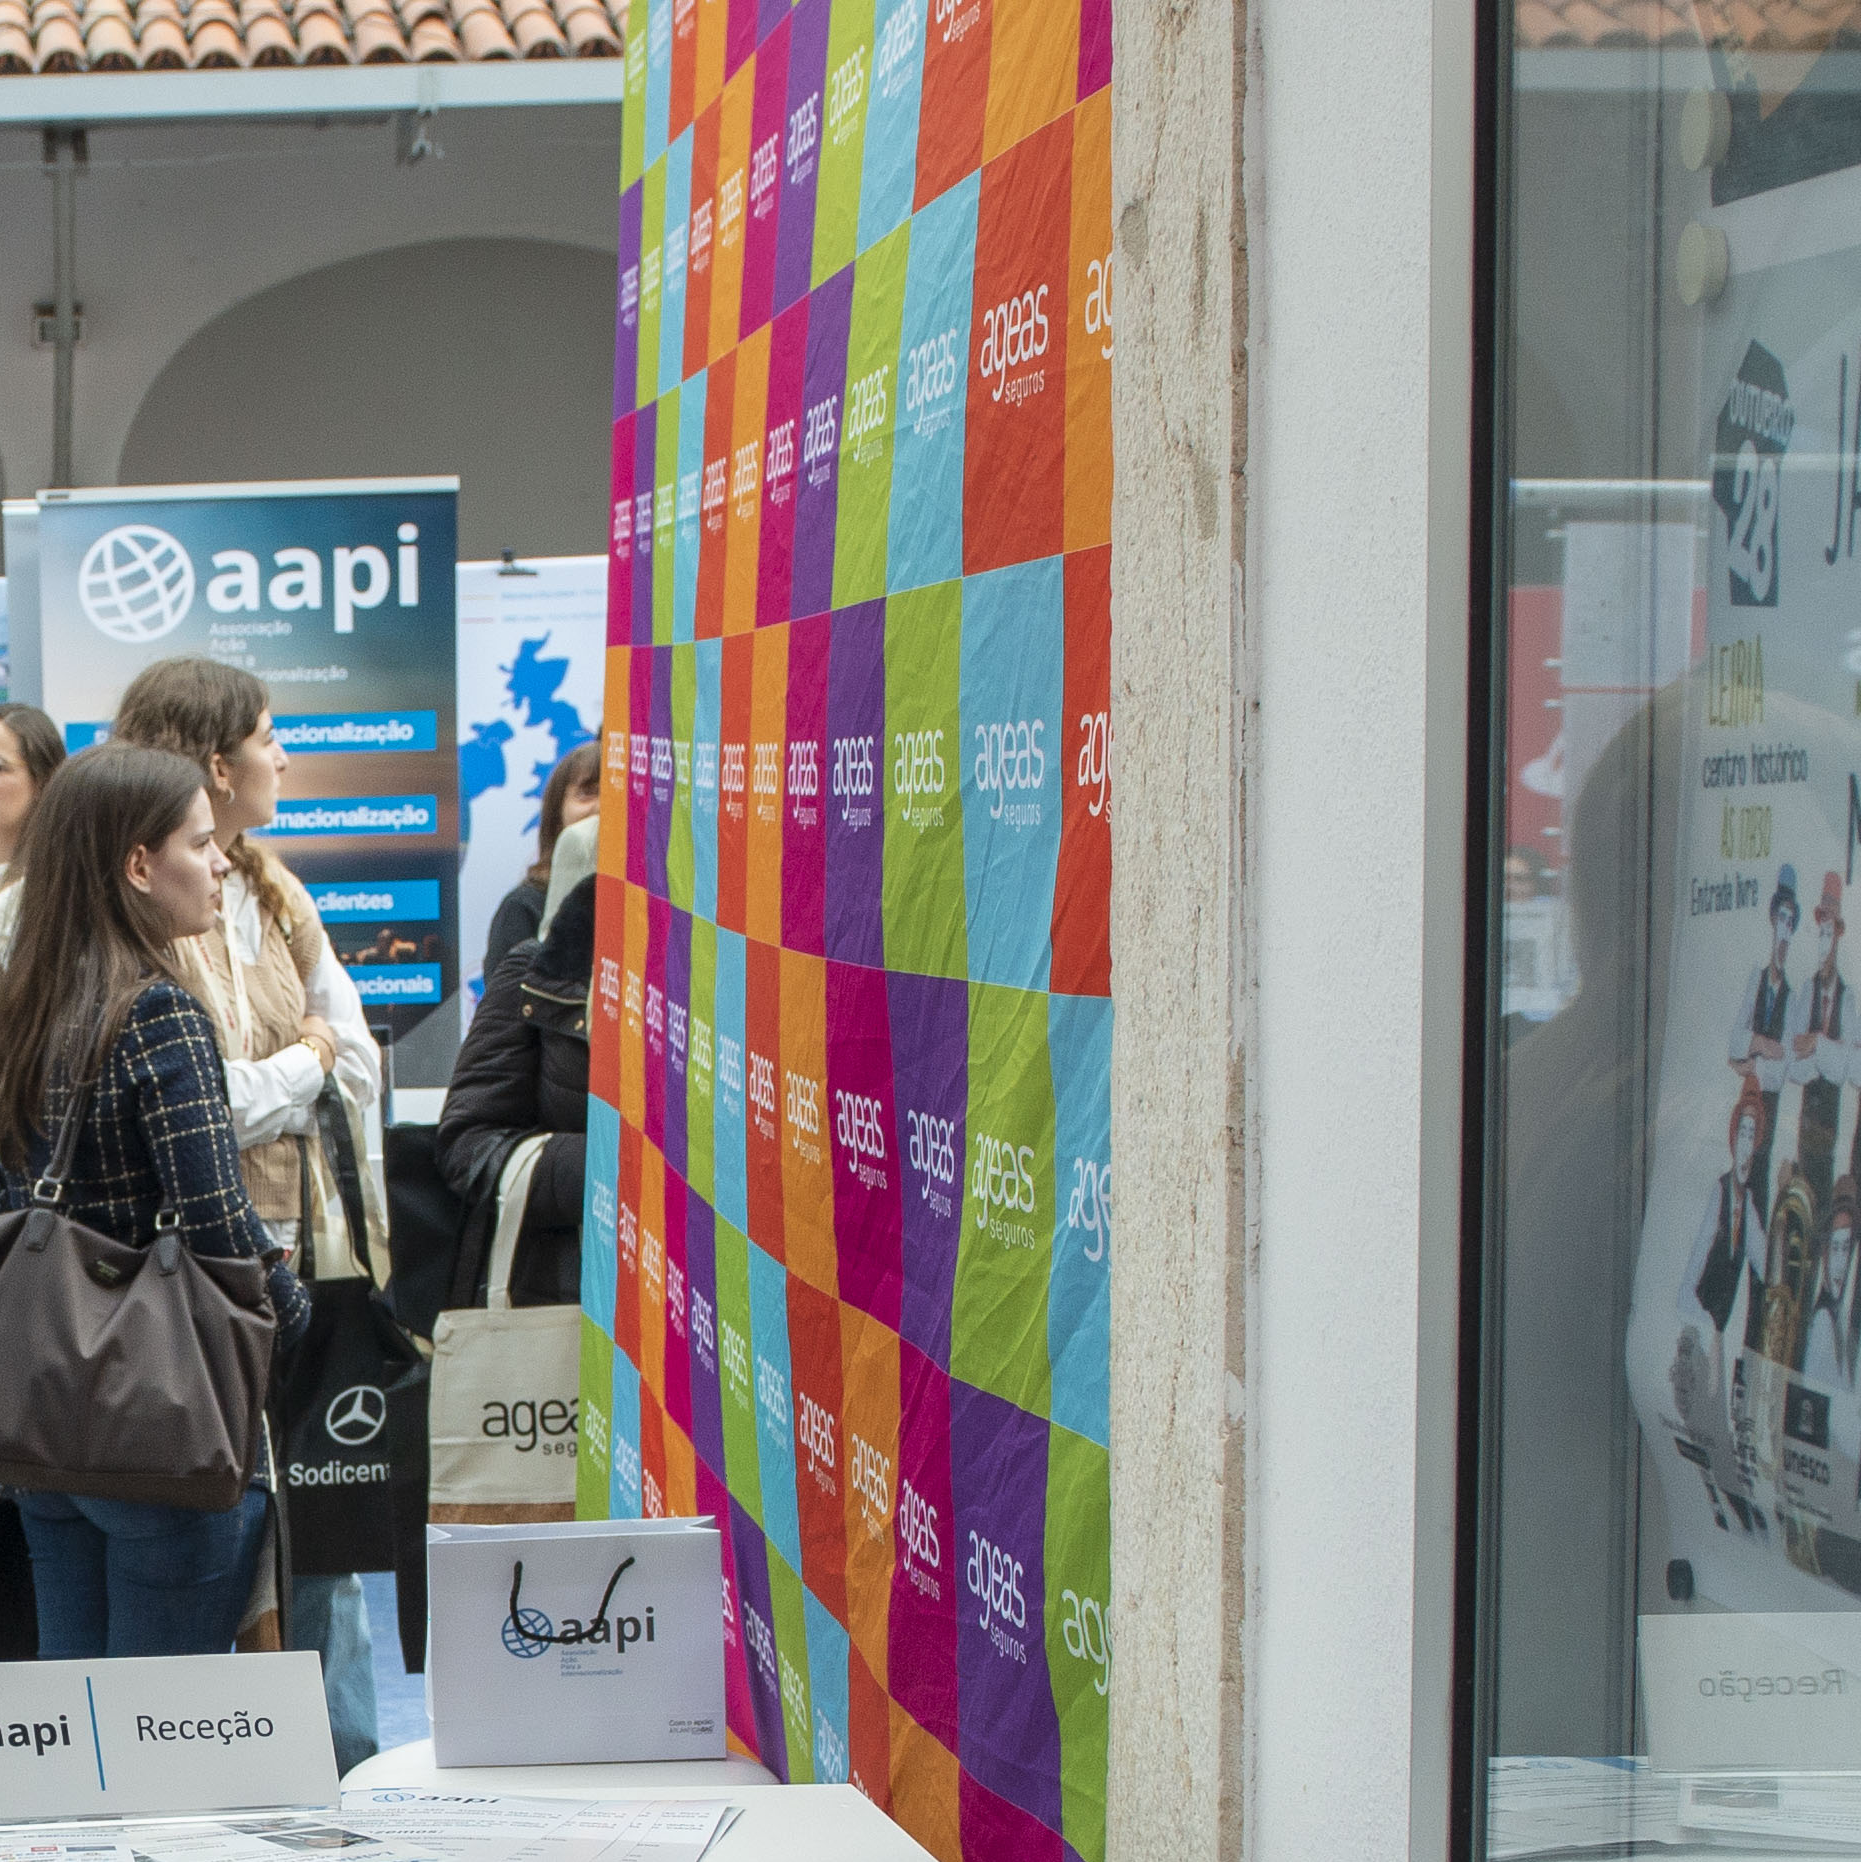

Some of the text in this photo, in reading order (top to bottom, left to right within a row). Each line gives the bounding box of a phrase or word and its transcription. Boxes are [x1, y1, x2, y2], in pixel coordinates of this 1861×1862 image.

[830, 45, 864, 145] ageas
[907, 328, 957, 434] ageas
[981, 284, 1049, 402] ageas
[848, 365, 889, 462] ageas
[1005, 367, 1046, 407] seguros
[804, 395, 838, 484] ageas
[1729, 436, 1780, 602] 28
[206, 522, 419, 633] aapi
[1708, 634, 1765, 729] LEIRIA
[788, 741, 818, 819] ageas
[832, 735, 876, 819] ageas
[894, 728, 945, 818] ageas
[975, 718, 1045, 818] ageas
[1702, 742, 1808, 788] centro histórico
[848, 806, 872, 826] seguros
[911, 805, 945, 827] seguros
[1004, 803, 1041, 826] seguros
[786, 1070, 819, 1148] ageas
[836, 1087, 884, 1173] ageas
[858, 1164, 888, 1191] seguros
[907, 1108, 955, 1199] ageas
[973, 1128, 1036, 1230] ageas
[989, 1218, 1036, 1251] seguros
[799, 1392, 836, 1472] ageas
[851, 1433, 890, 1518] ageas
[900, 1478, 941, 1571] ageas
[910, 1565, 941, 1602] seguros
[967, 1530, 1027, 1630] ageas
[558, 1605, 655, 1654] aapi
[990, 1622, 1027, 1665] seguros
[136, 1711, 274, 1745] Receção
[418, 1795, 501, 1804] aapi
